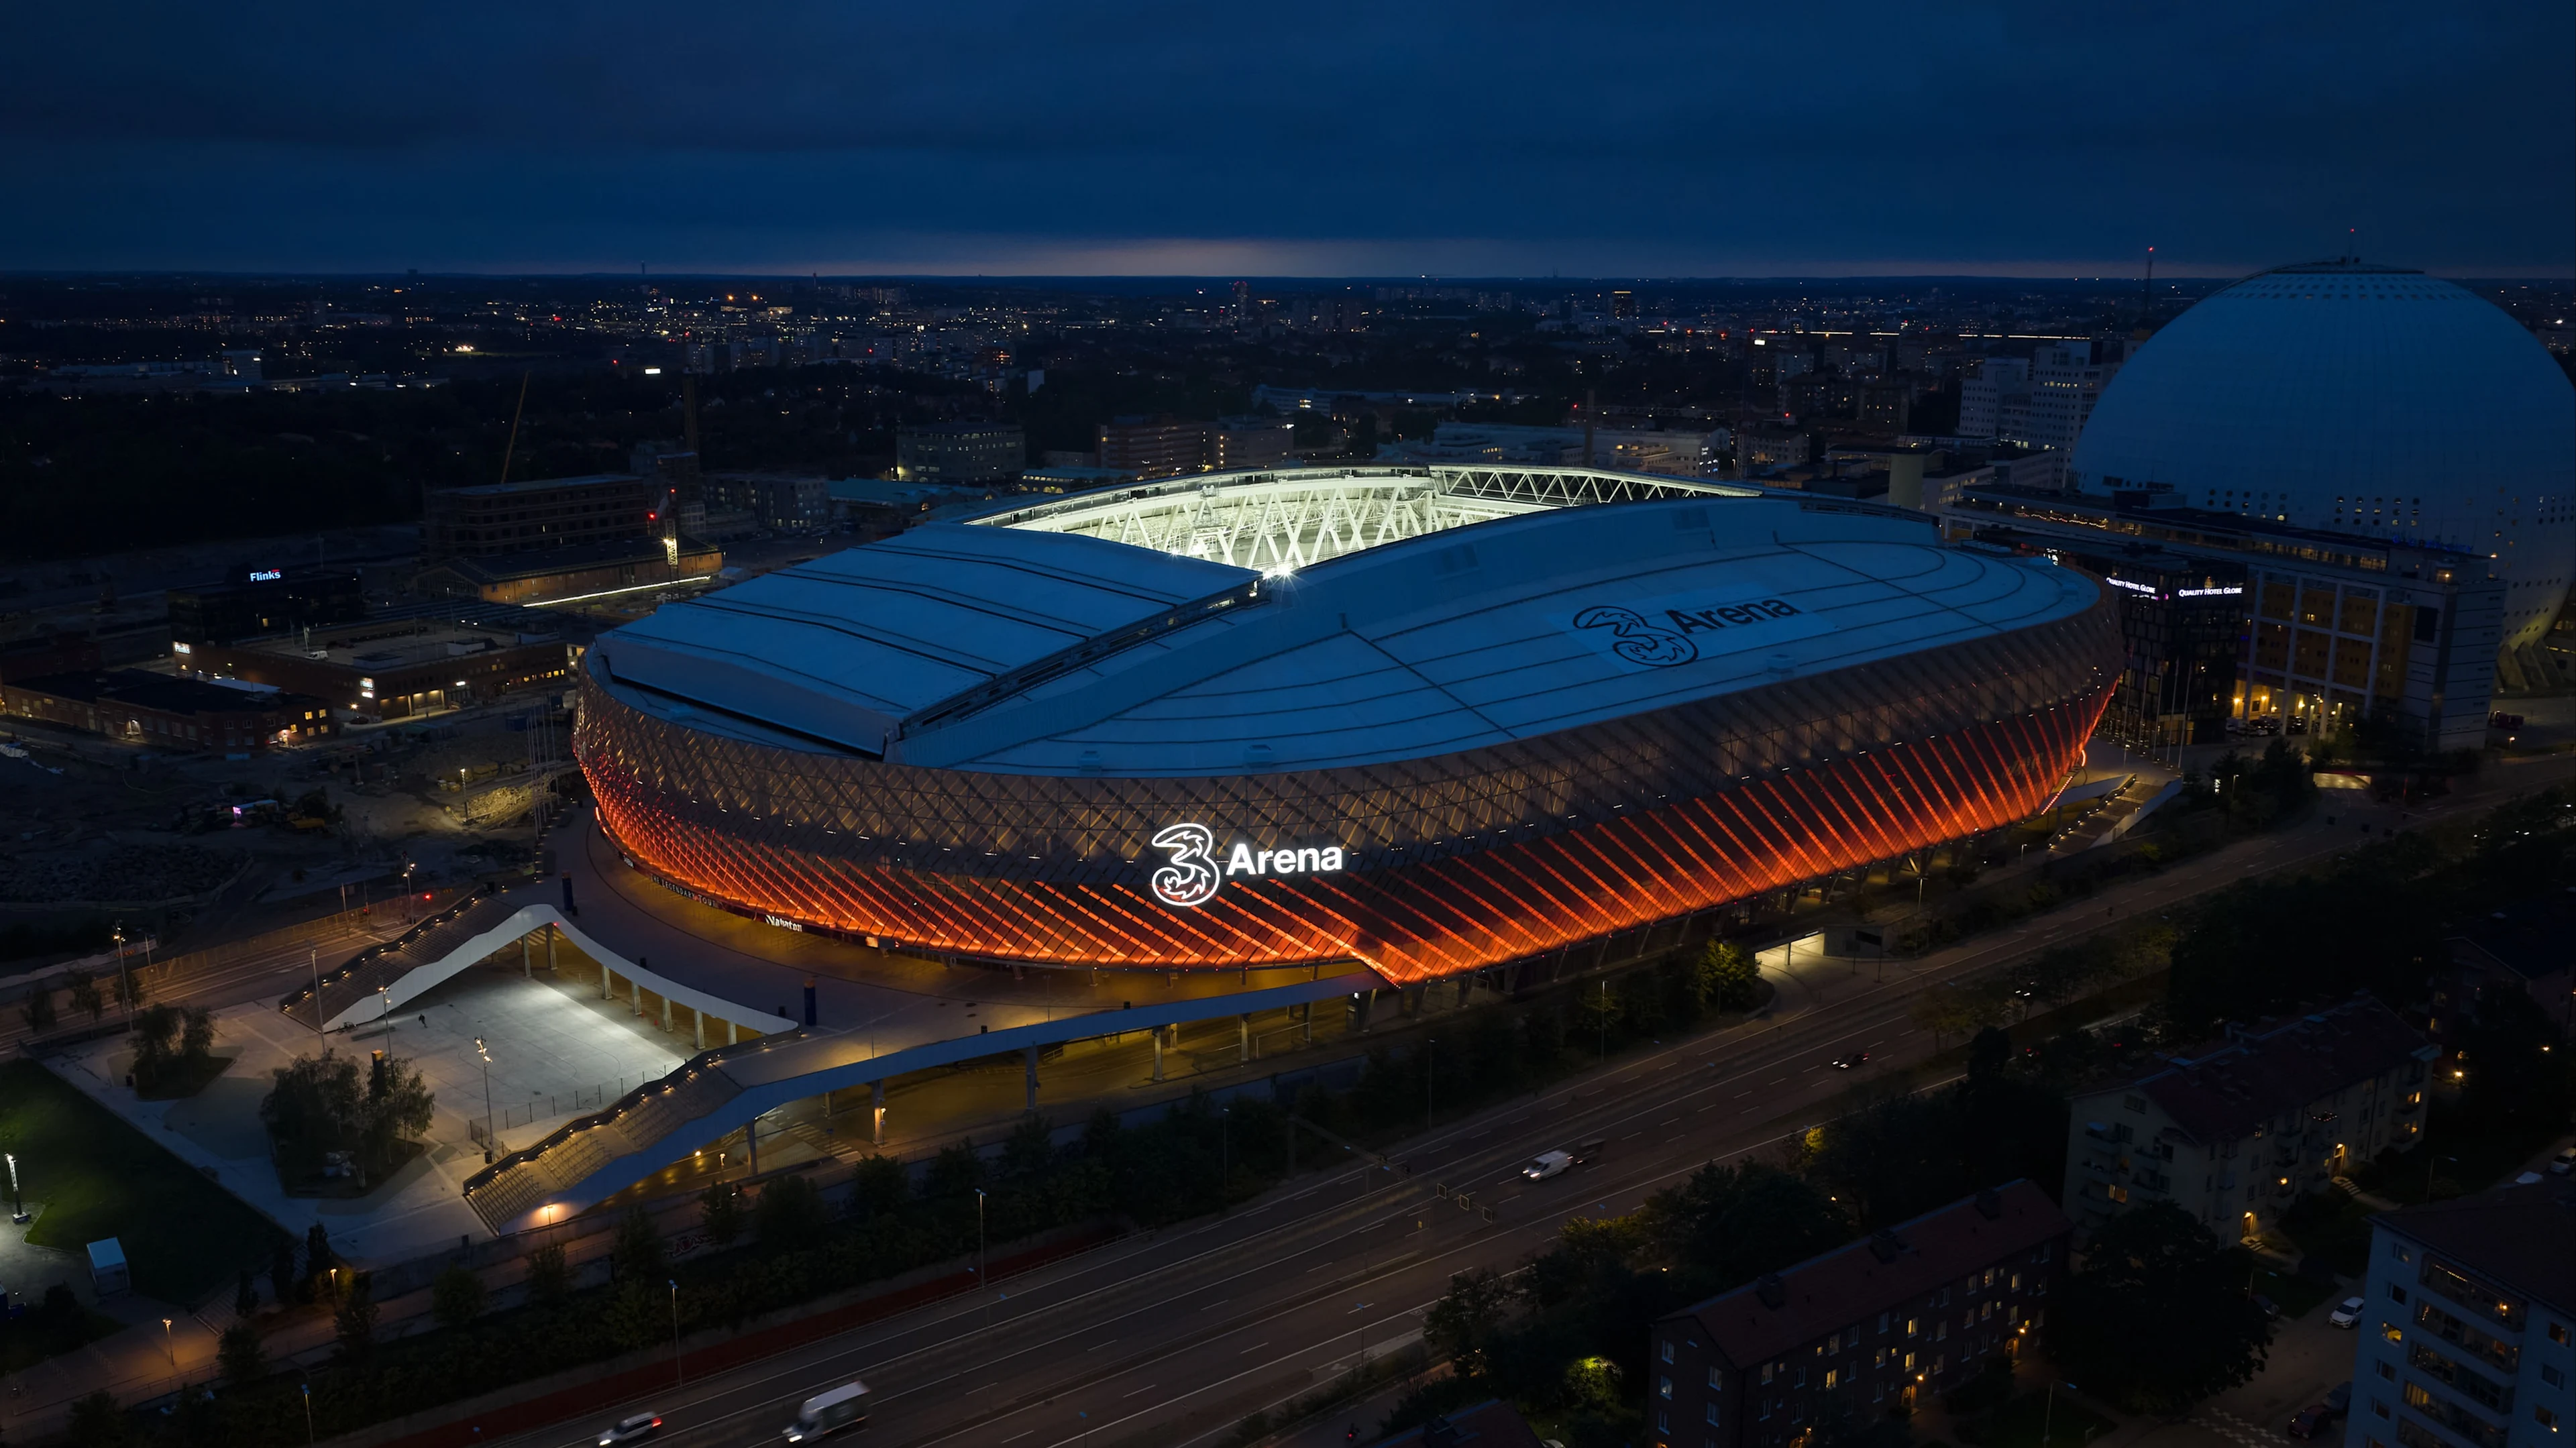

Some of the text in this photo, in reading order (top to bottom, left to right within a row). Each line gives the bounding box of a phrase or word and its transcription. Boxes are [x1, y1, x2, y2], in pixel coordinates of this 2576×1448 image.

[250, 571, 281, 581] Flinks
[2125, 581, 2140, 591] HOTEL
[2140, 584, 2155, 594] GLOBE
[2179, 589, 2204, 597] QUALITY
[1666, 600, 1802, 634] Arena
[1226, 843, 1342, 875] Arena
[661, 879, 695, 898] LEGENDARY
